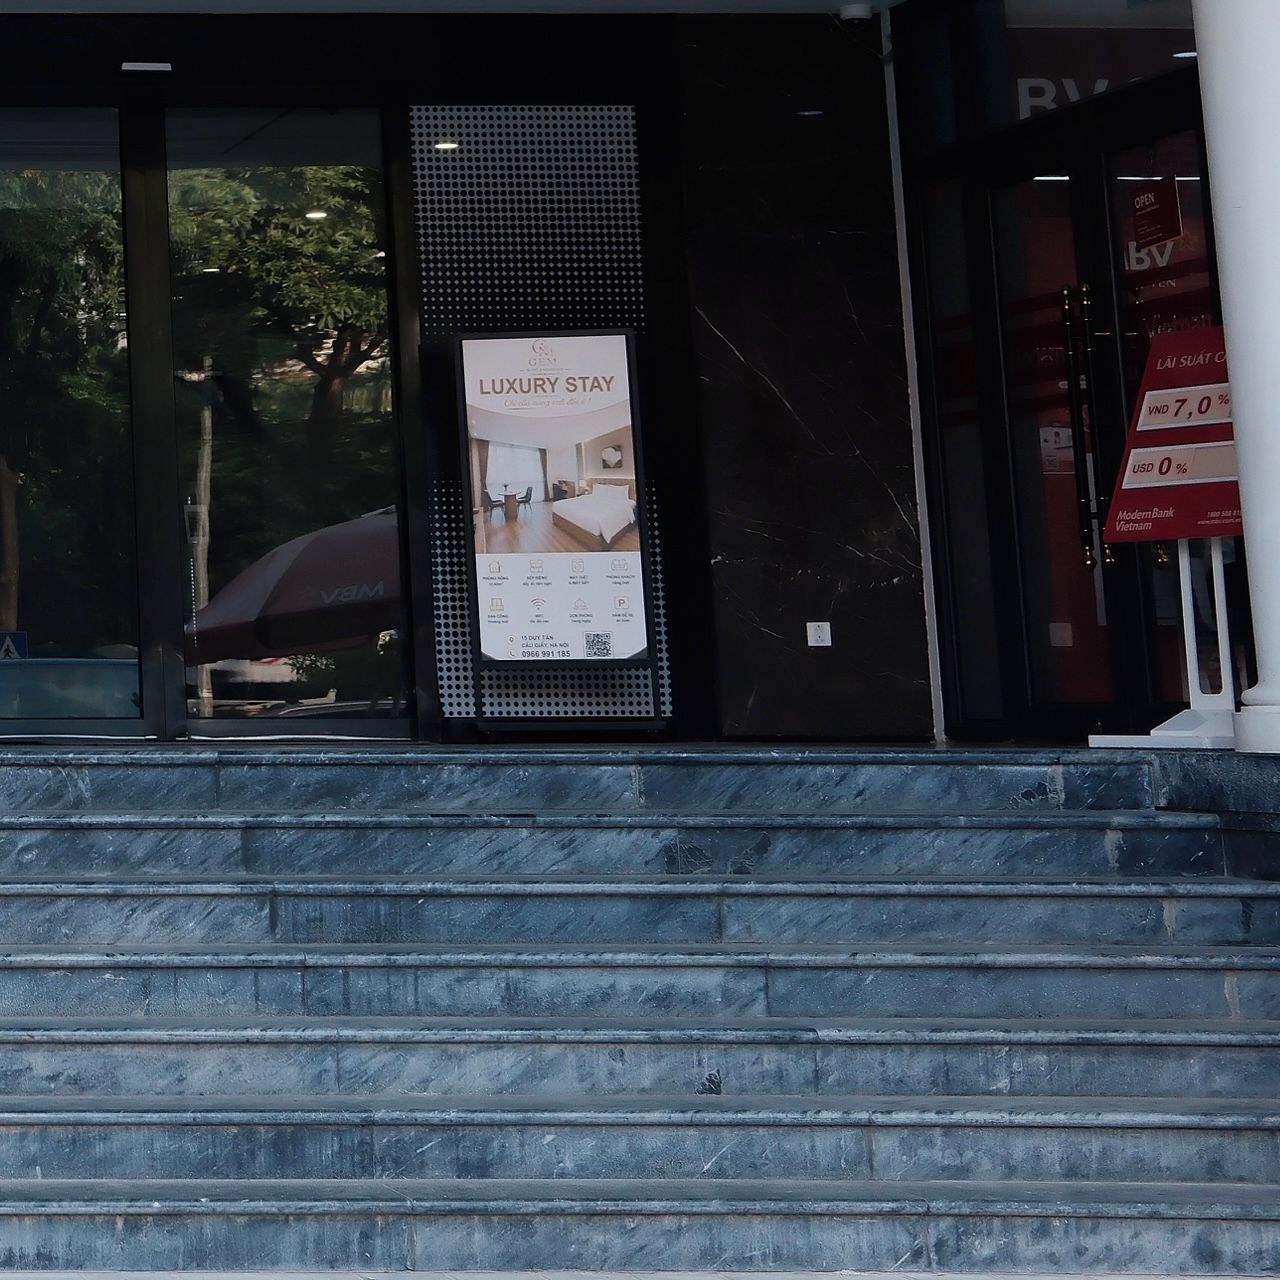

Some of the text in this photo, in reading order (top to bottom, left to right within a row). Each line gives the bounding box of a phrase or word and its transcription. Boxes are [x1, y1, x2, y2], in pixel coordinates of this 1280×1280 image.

[1134, 191, 1155, 209] OPEN
[1156, 355, 1177, 370] LÃI
[479, 375, 615, 396] LUXURY STAY
[1148, 404, 1169, 416] VND
[1173, 395, 1212, 420] 7,0
[1132, 456, 1188, 476] USD 0 %
[1115, 521, 1153, 532] Vietnam
[557, 650, 571, 658] 185
